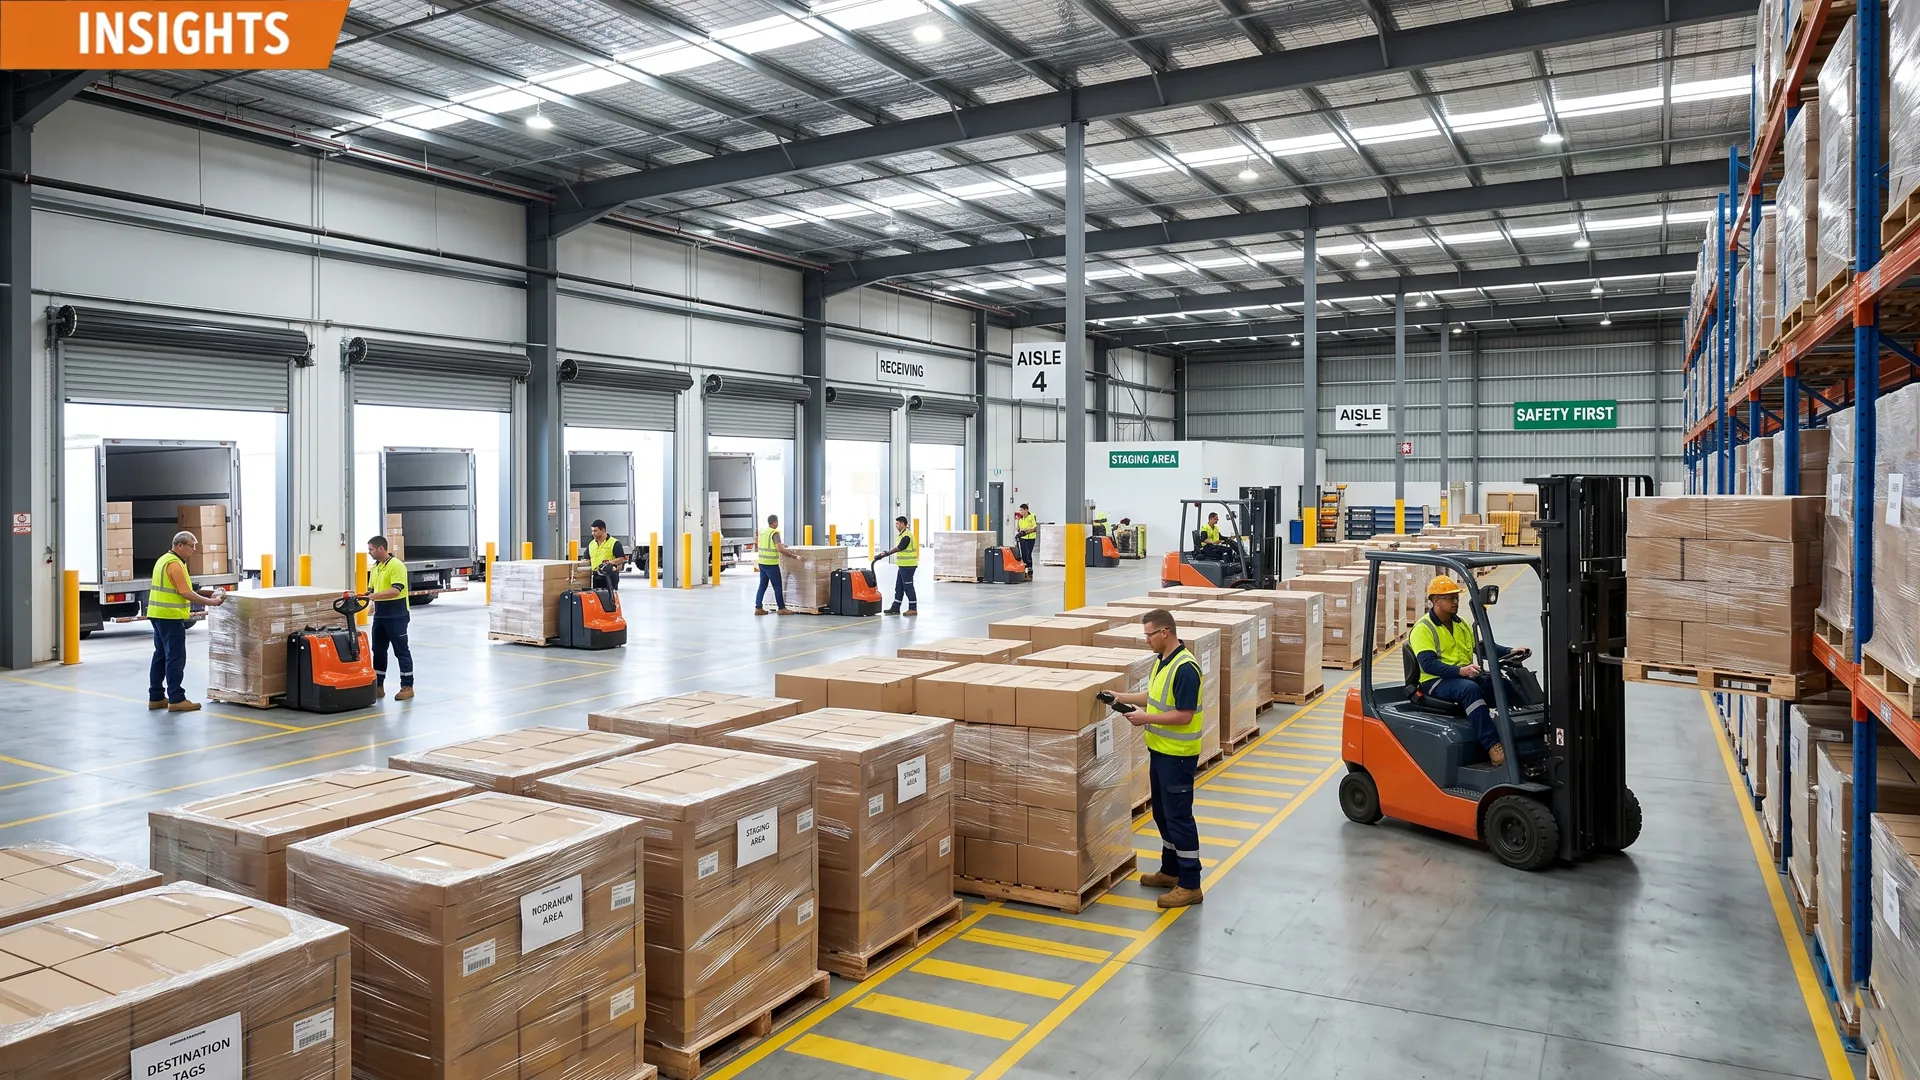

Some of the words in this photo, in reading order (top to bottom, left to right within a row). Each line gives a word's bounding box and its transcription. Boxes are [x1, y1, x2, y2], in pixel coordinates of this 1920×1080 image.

[1016, 350, 1062, 366] AISLE
[880, 359, 924, 378] RECEIVING
[1031, 370, 1048, 393] 4
[1340, 408, 1382, 421] AISLE
[1516, 407, 1569, 422] SAFETY
[1573, 406, 1614, 421] FIRST
[1111, 454, 1150, 465] STAGING
[1151, 454, 1177, 464] AREA
[750, 835, 766, 847] AREA
[542, 911, 564, 926] AREA
[147, 1037, 231, 1077] DESTINATION
[172, 1063, 206, 1080] TAGS
